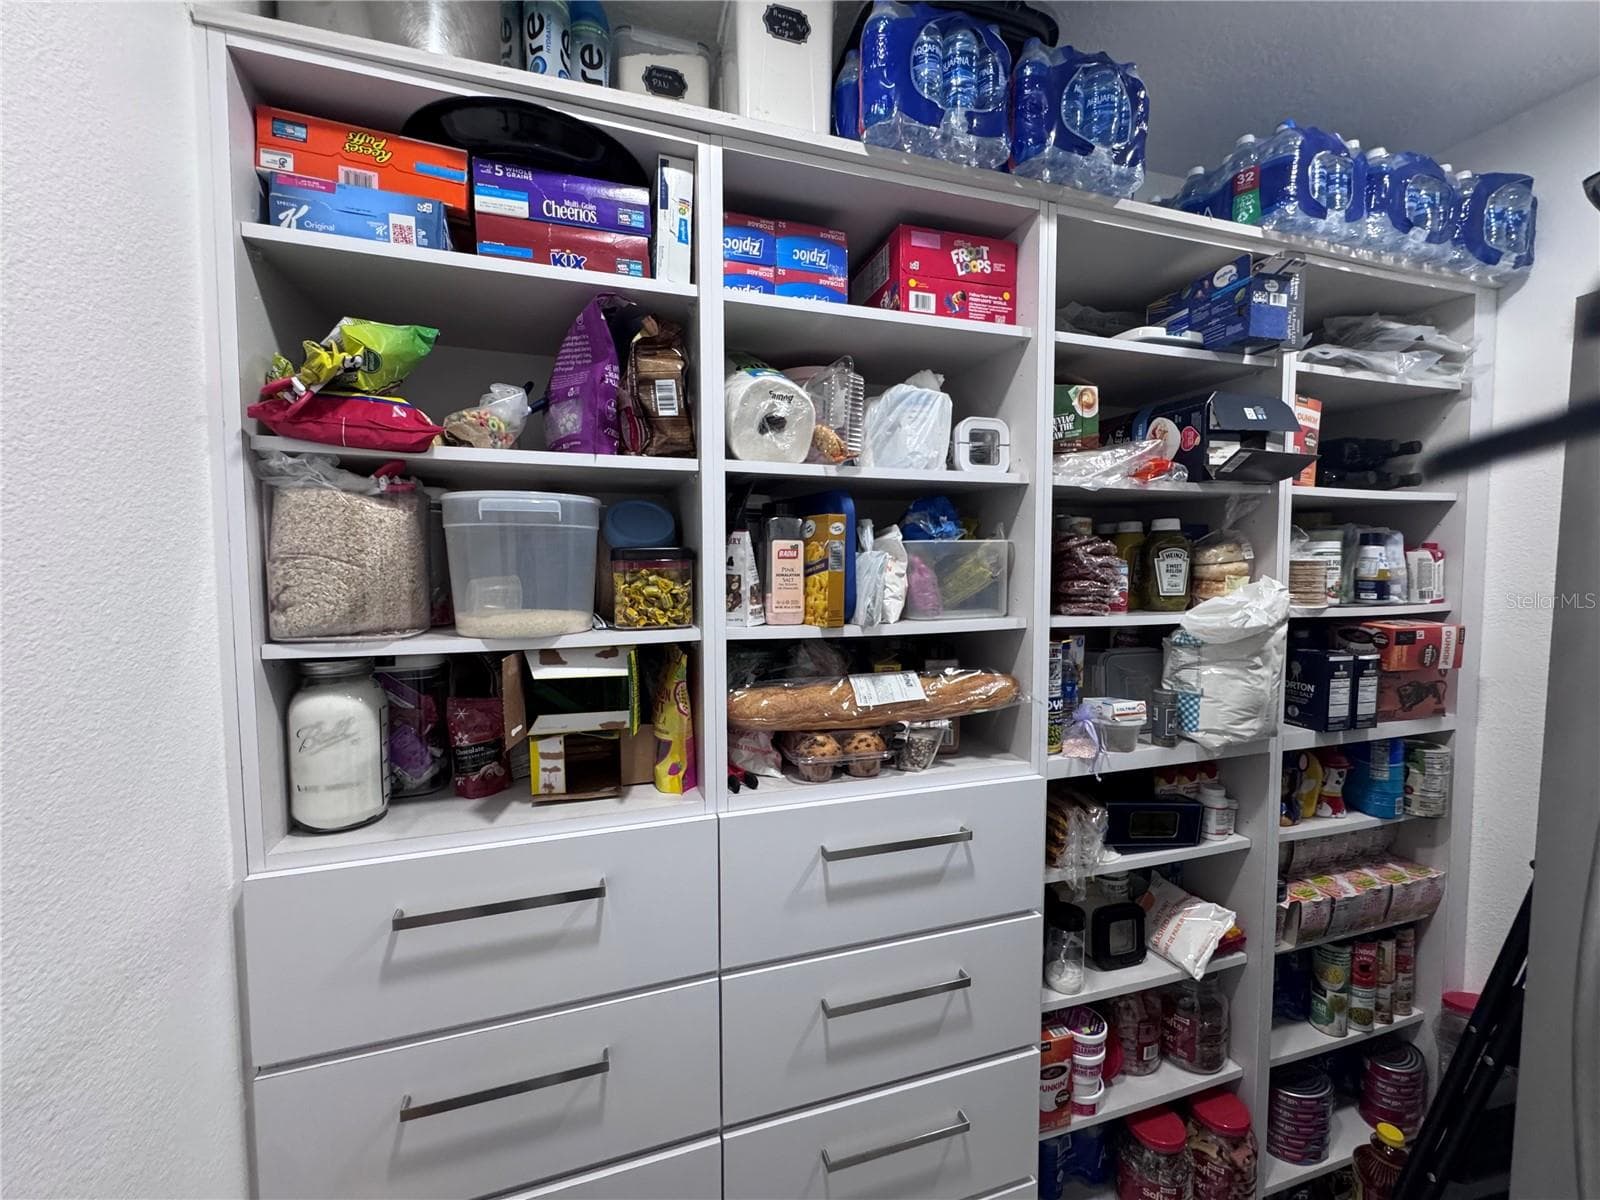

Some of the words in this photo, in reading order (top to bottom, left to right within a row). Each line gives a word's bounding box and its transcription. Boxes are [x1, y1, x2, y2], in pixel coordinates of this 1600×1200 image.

[347, 131, 388, 150] Puffs
[494, 164, 504, 177] 5
[506, 172, 533, 181] GRAINS
[1236, 171, 1255, 185] 32
[542, 199, 598, 225] Cheerios
[304, 220, 335, 232] Original
[724, 236, 760, 256] Ziploc
[792, 248, 827, 266] Ziploc
[951, 246, 989, 265] FROOT
[956, 260, 992, 276] LOOPS
[1285, 681, 1315, 693] ORTON
